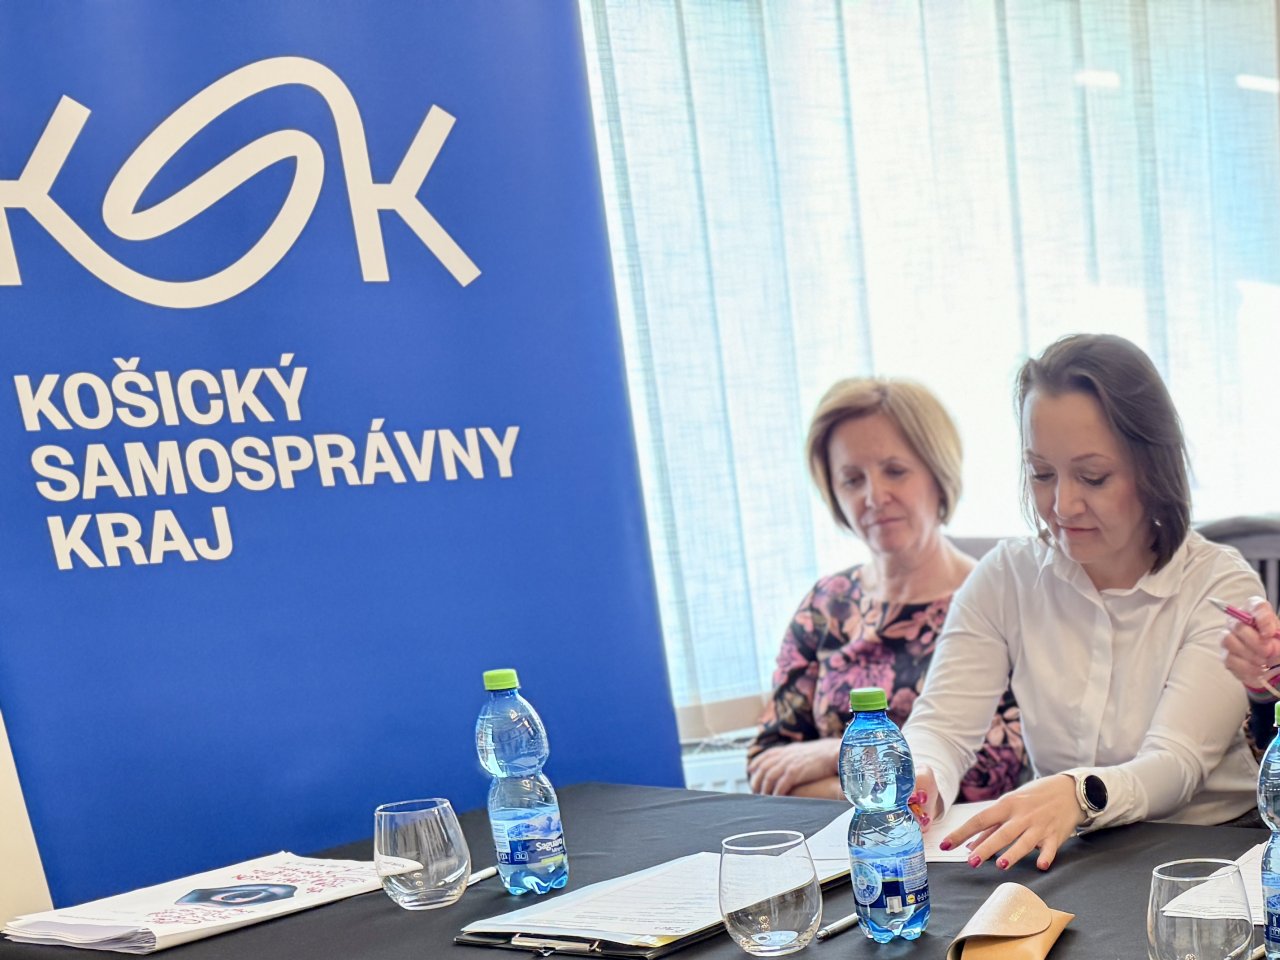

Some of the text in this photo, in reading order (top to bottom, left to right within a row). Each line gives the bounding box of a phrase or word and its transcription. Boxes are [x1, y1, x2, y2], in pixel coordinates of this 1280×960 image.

[14, 353, 308, 431] KOŠICKÝ
[31, 419, 520, 502] SAMOSPRÁVNY
[47, 506, 233, 571] KRAJ
